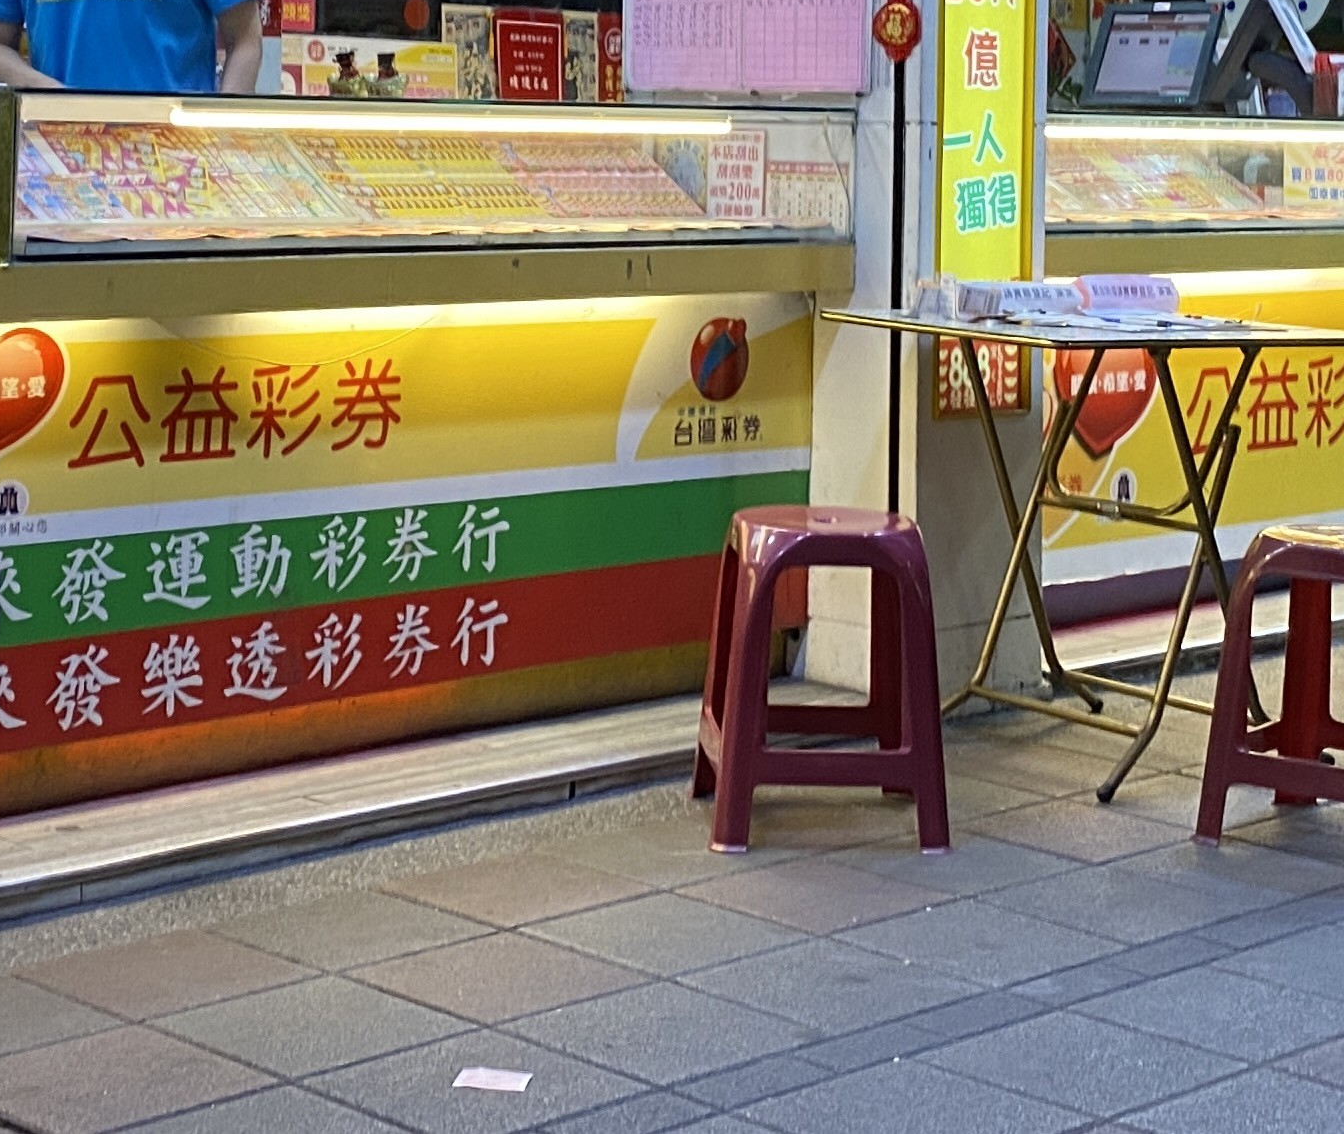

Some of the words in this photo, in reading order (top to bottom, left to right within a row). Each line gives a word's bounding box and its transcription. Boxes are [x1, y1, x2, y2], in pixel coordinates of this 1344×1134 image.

[964, 31, 999, 87] 億
[943, 114, 1004, 163] 一人
[957, 172, 1017, 231] 獨得
[68, 356, 403, 470] 公益彩券
[672, 413, 763, 449] 台灣彩券
